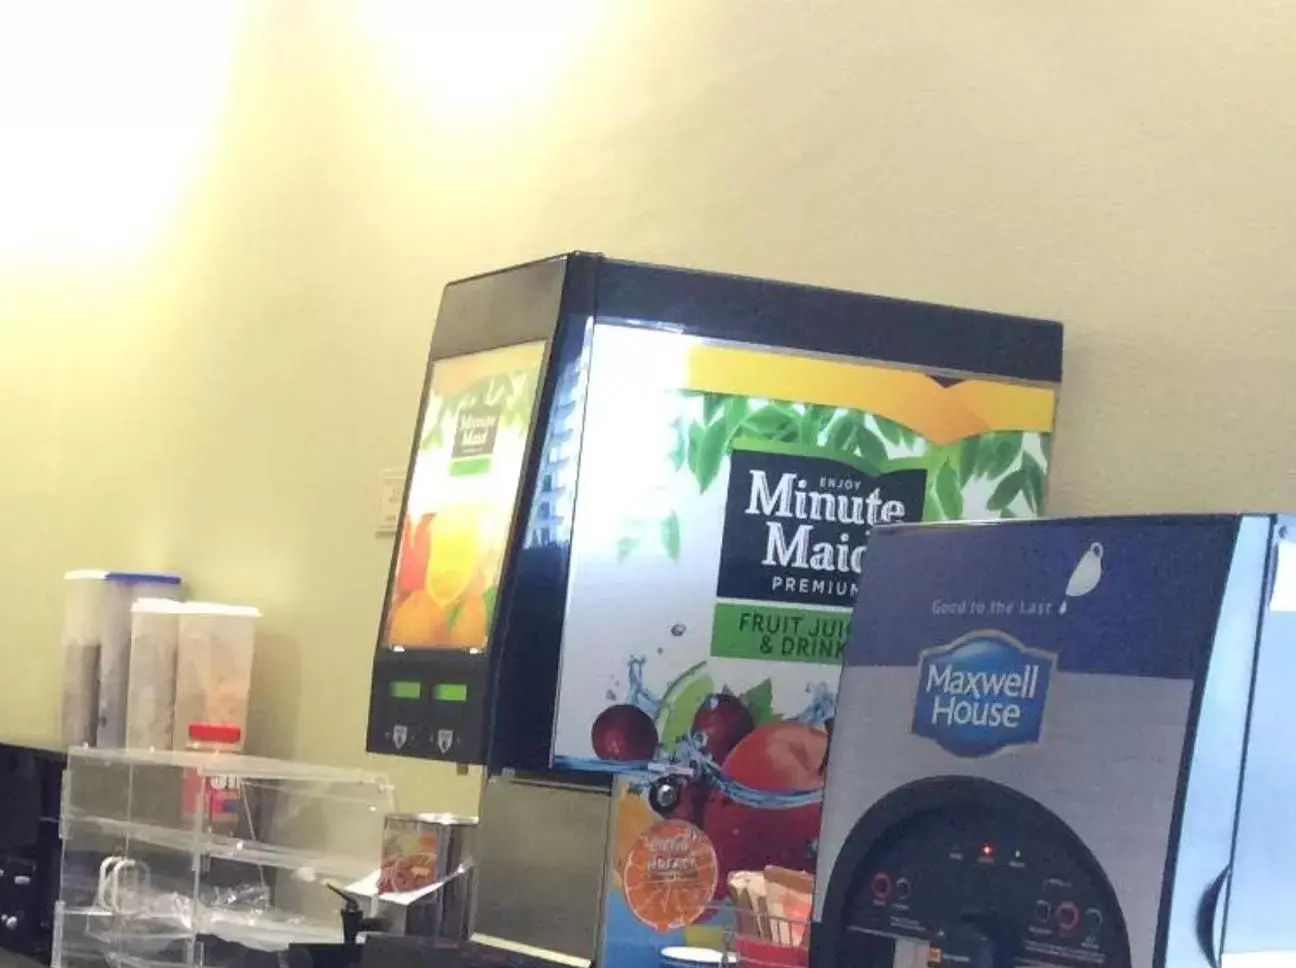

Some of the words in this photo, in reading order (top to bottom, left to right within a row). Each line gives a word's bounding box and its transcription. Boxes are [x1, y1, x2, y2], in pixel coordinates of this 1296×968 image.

[819, 477, 861, 491] ENJOY
[744, 469, 905, 526] Minute
[931, 599, 966, 615] Good
[970, 600, 986, 615] to
[989, 599, 1014, 616] the
[1020, 600, 1052, 616] Last
[739, 612, 803, 635] FRUIT
[759, 635, 773, 655] &
[925, 663, 1040, 699] Maxwell
[931, 695, 1022, 728] House
